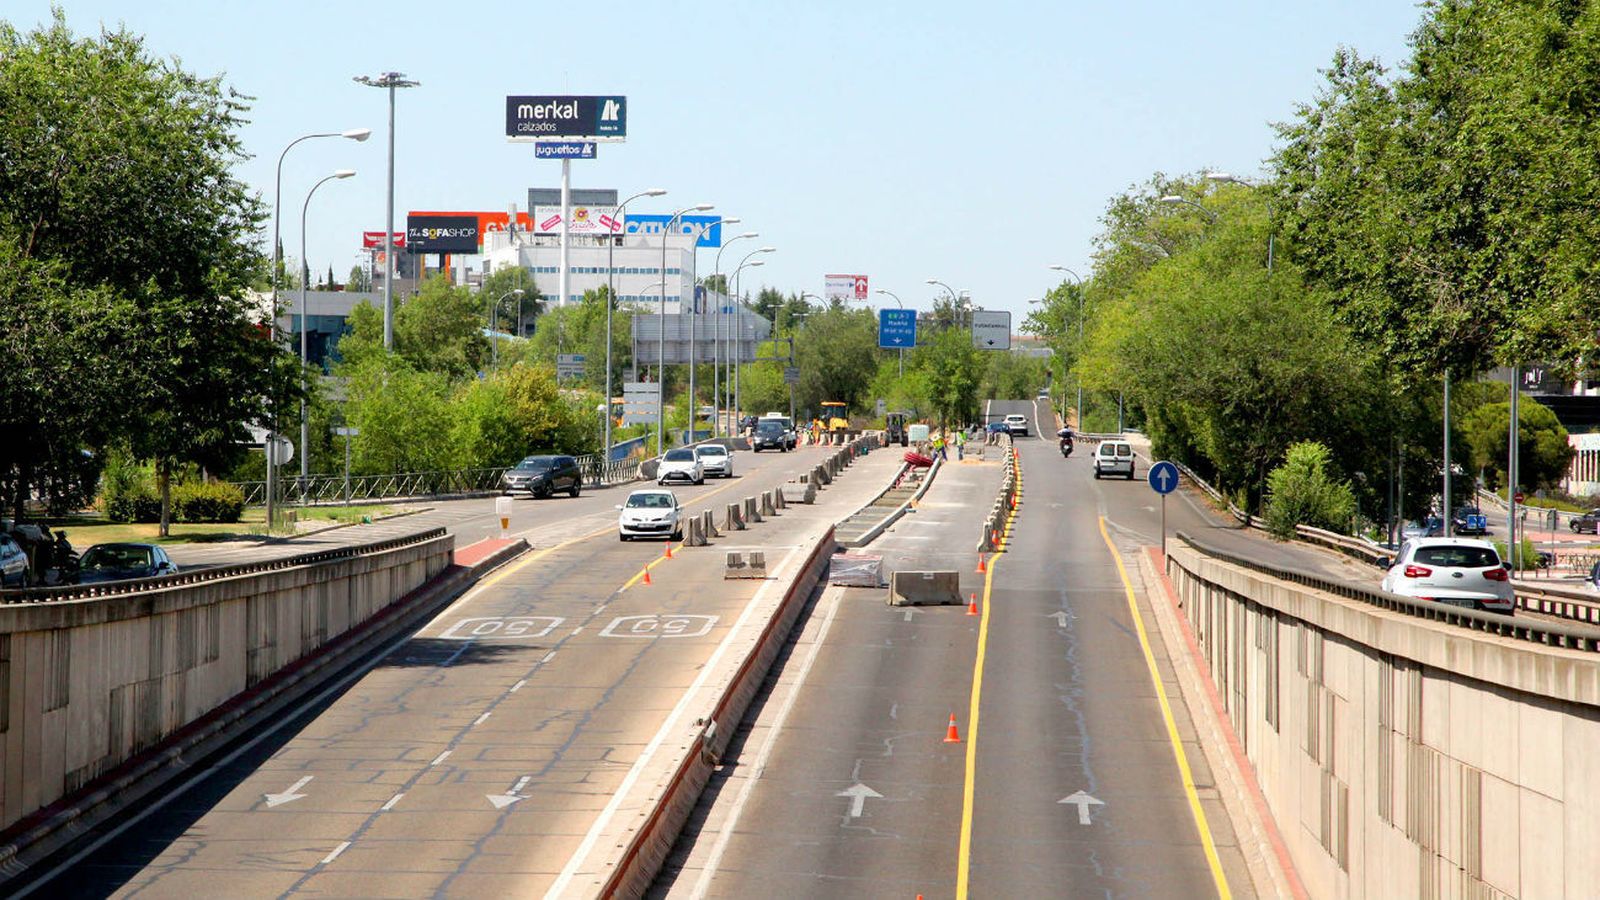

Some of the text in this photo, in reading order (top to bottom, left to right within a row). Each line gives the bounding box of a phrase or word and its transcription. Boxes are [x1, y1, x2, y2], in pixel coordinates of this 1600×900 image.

[517, 100, 578, 119] merkal
[517, 122, 557, 132] calzados
[536, 145, 580, 156] juguettos
[409, 228, 421, 237] The
[472, 620, 534, 635] 50
[632, 619, 691, 633] 50
